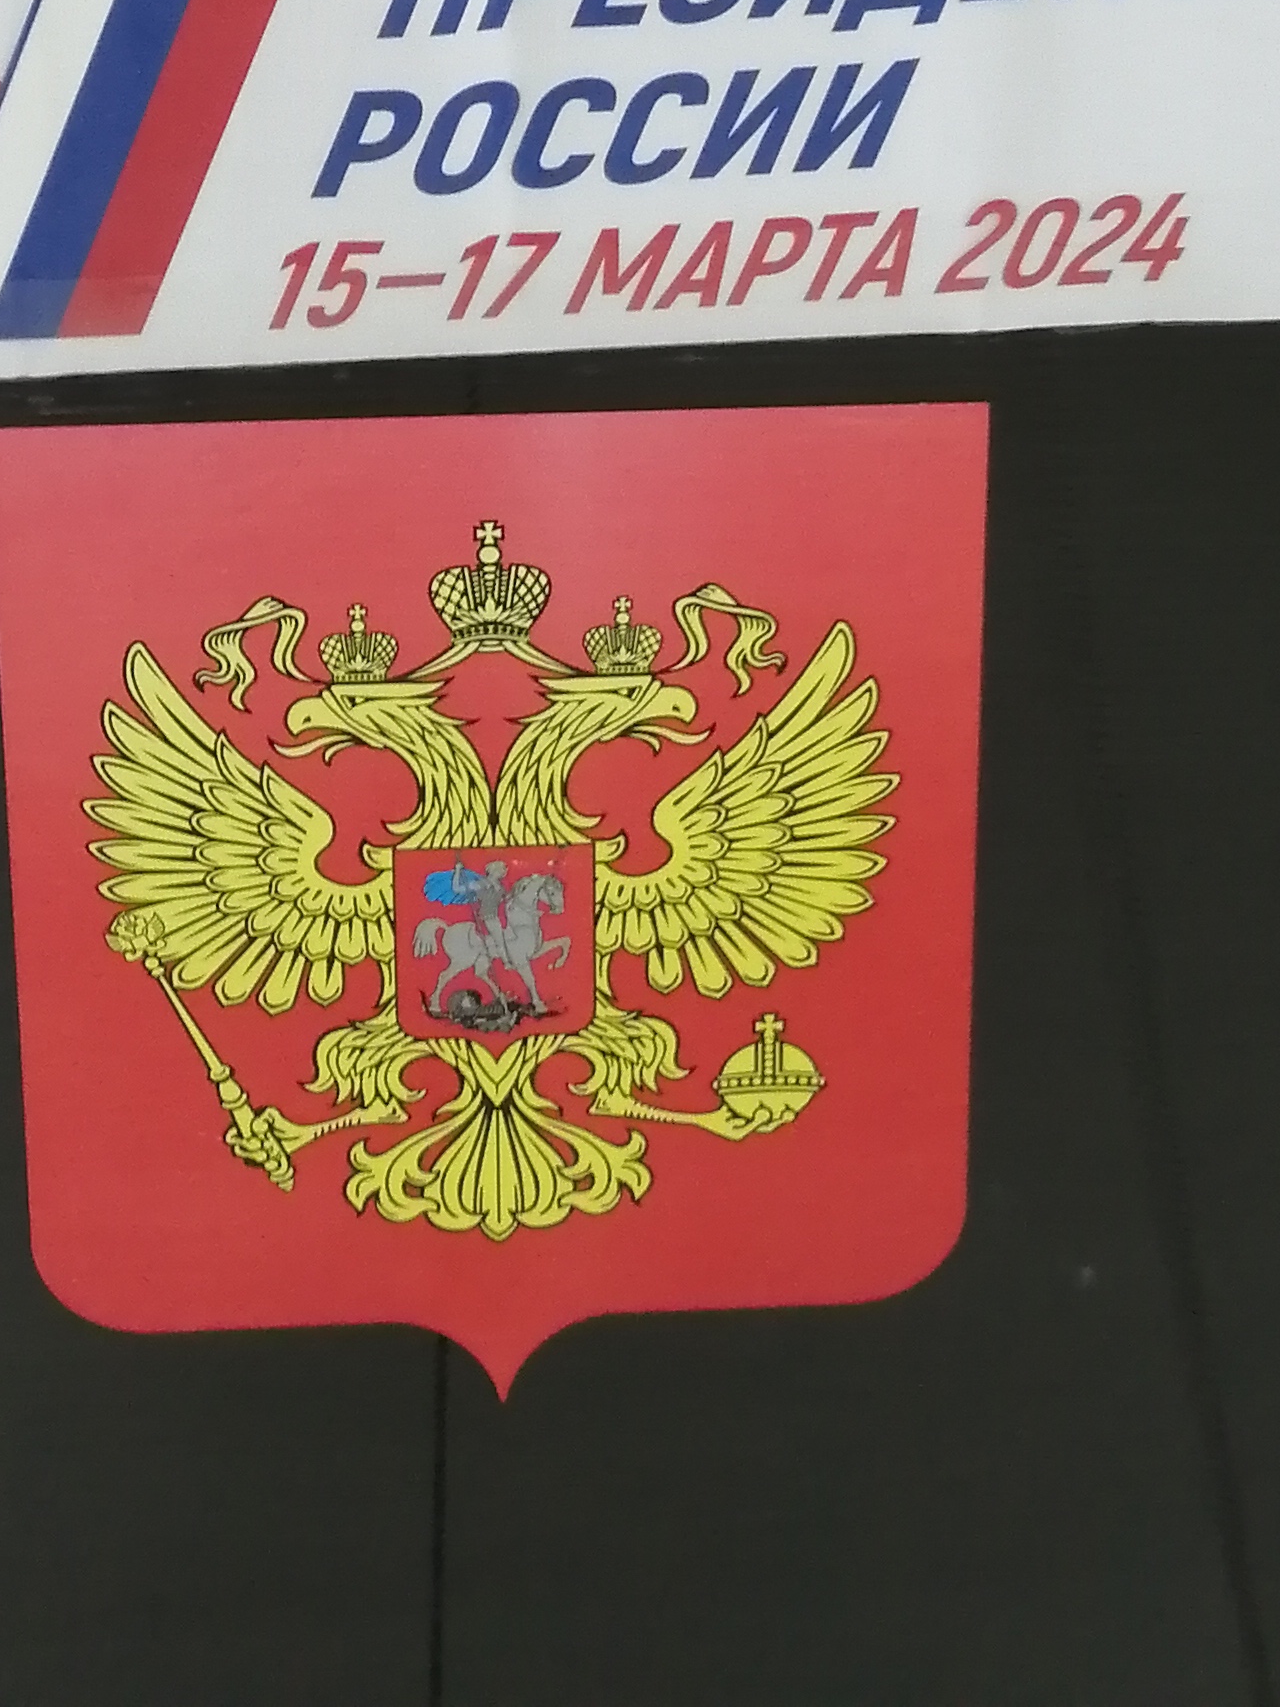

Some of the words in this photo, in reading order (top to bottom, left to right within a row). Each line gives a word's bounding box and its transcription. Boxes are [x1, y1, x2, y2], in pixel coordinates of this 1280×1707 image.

[311, 59, 918, 198] РОССИИ
[564, 208, 919, 314] МАРТА
[936, 192, 1187, 295] 2024
